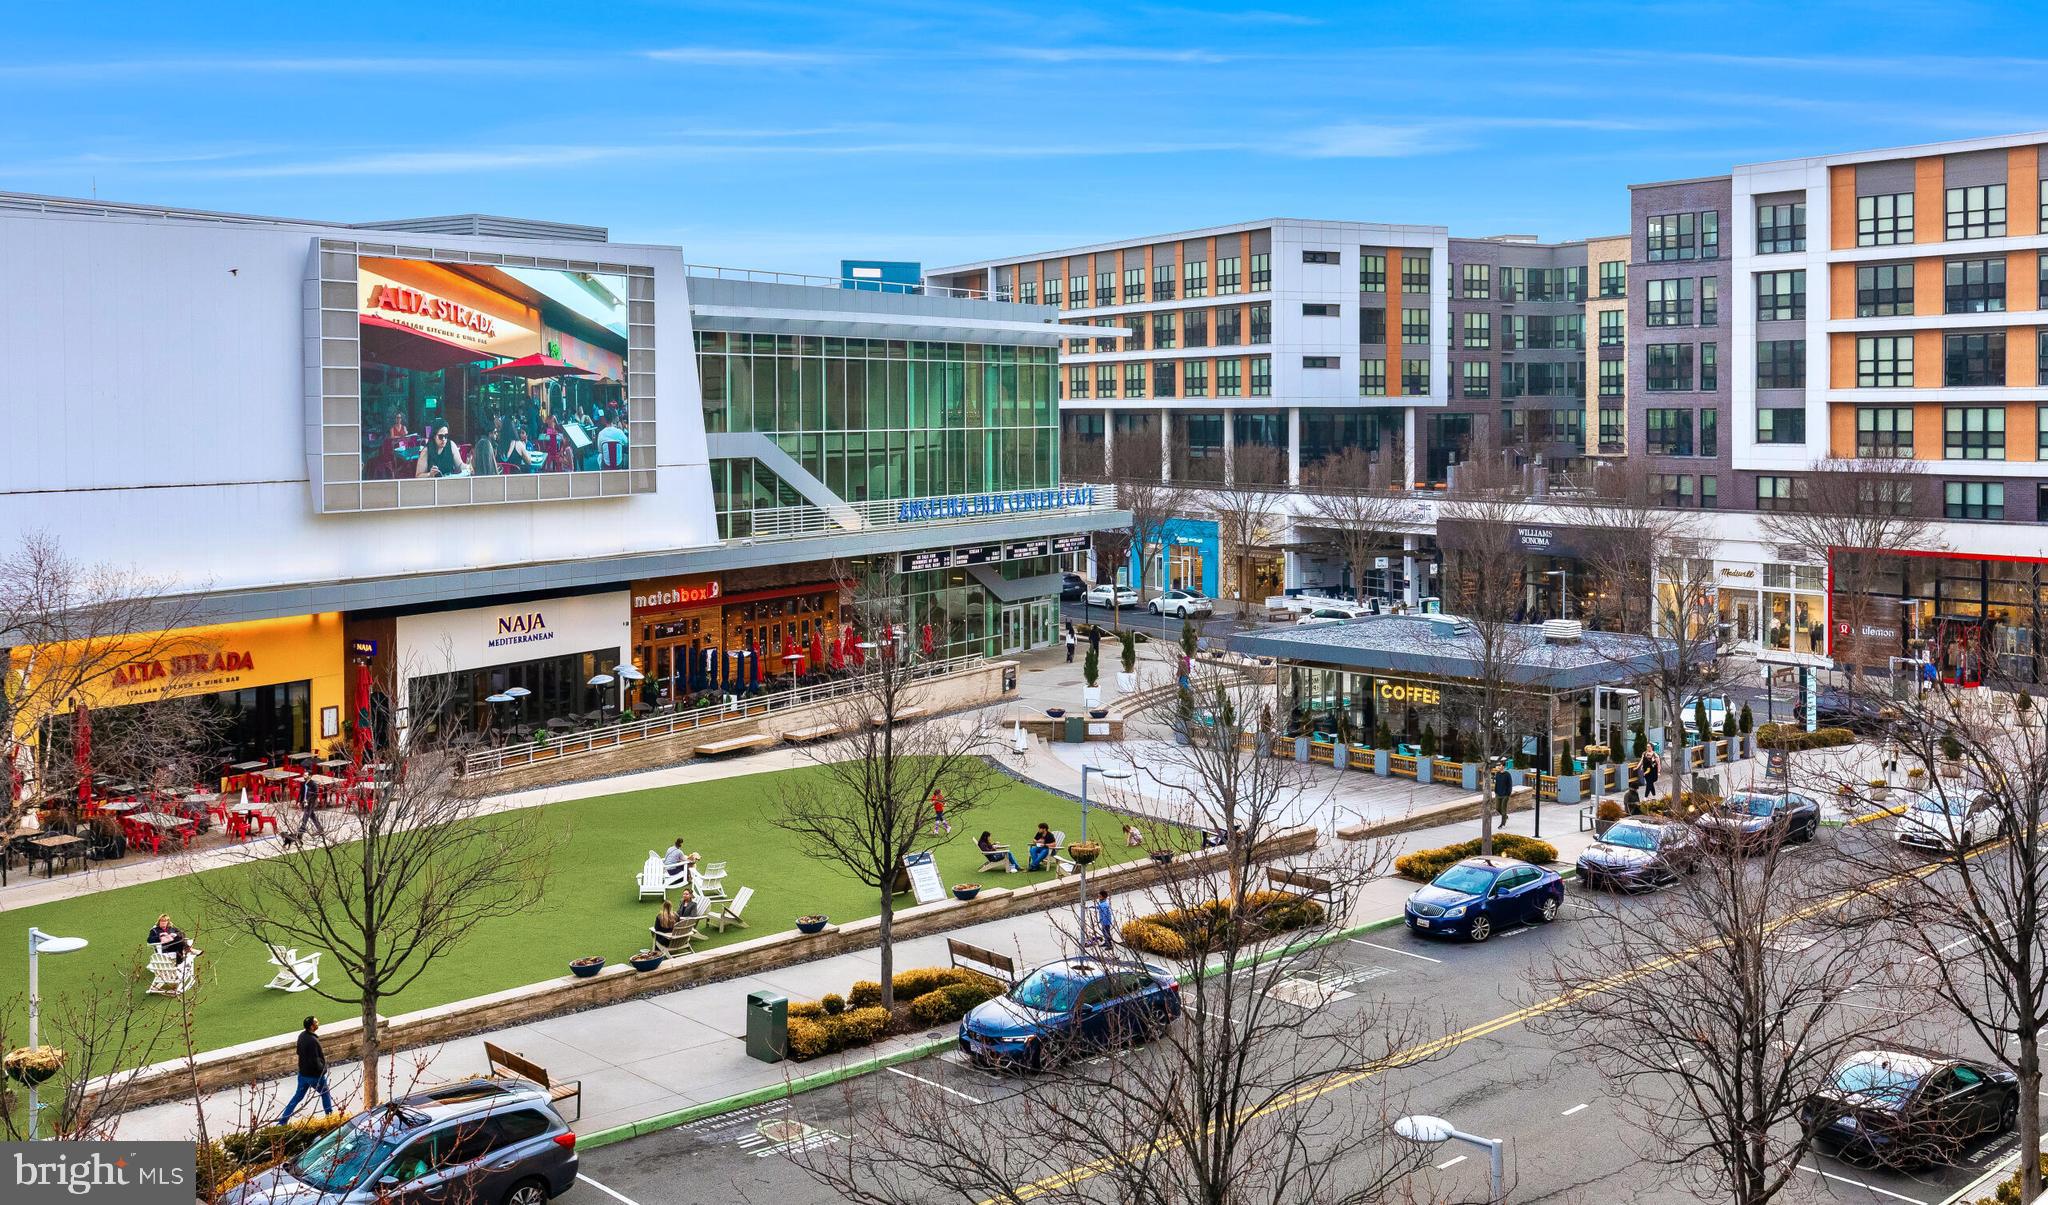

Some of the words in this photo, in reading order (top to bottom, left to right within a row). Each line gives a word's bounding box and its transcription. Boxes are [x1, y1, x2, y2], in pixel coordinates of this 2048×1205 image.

[373, 284, 434, 317] ALTA
[436, 299, 496, 338] STRADA
[898, 495, 969, 522] ANGELIKA
[974, 495, 1004, 514] FILM
[1009, 491, 1055, 513] CENTER
[1518, 528, 1553, 538] WILLIAMS
[1521, 536, 1550, 545] SONOMA
[634, 588, 707, 607] matchbox
[497, 612, 546, 635] NAJA
[356, 643, 373, 652] NAJA
[487, 632, 554, 648] MEDITERRANEAN
[112, 660, 166, 688] ALTA
[171, 651, 254, 676] STRADA
[126, 686, 158, 697] ITALIAN
[205, 677, 223, 685] WINE
[226, 675, 240, 683] BAR
[1381, 684, 1440, 705] COFFEE
